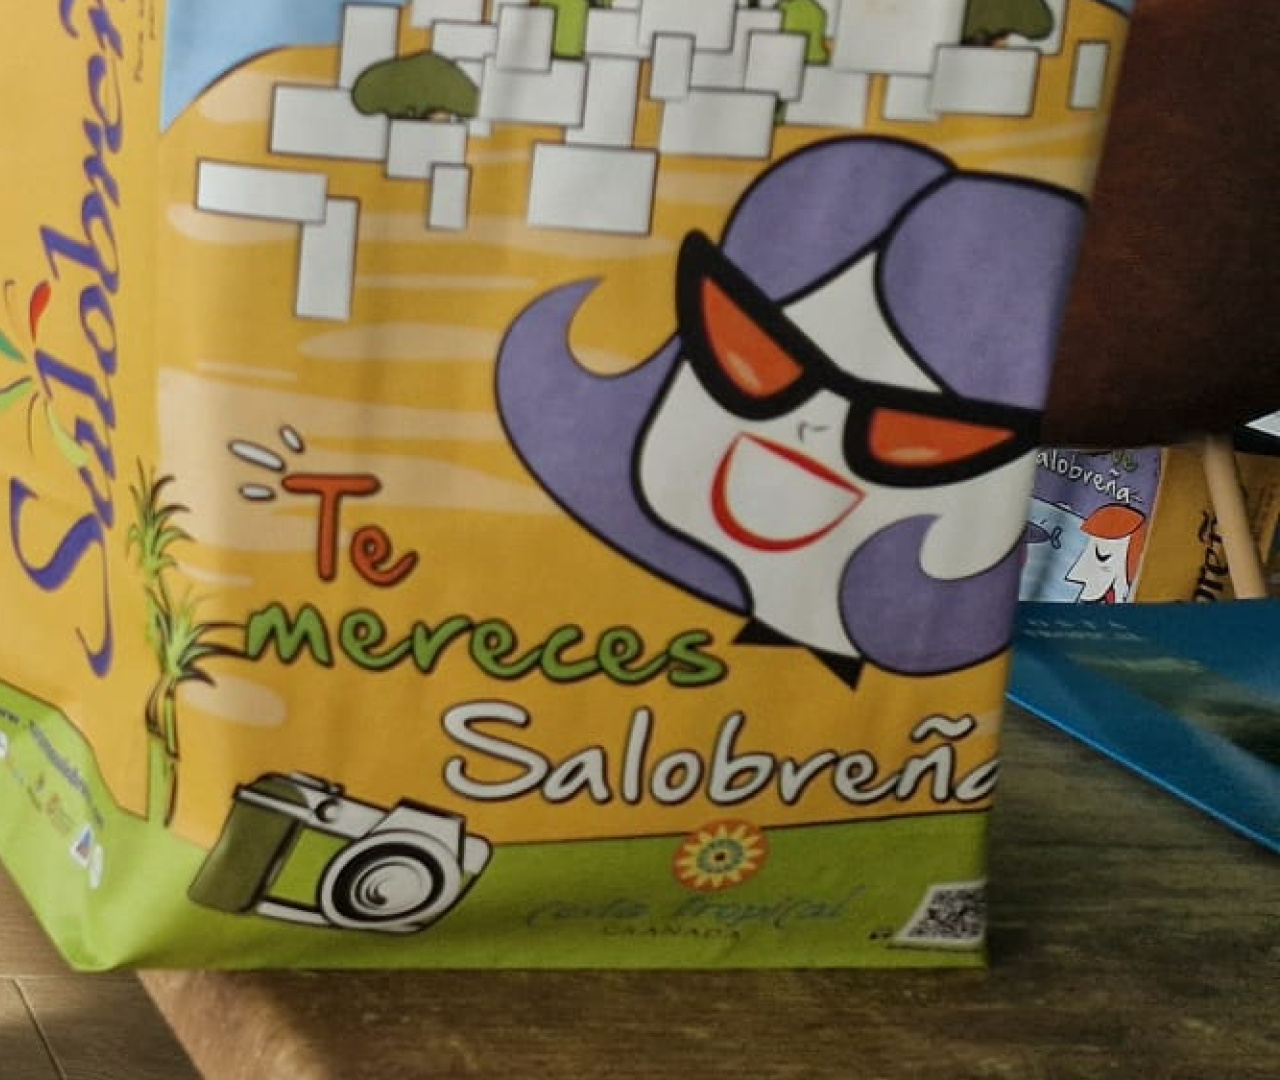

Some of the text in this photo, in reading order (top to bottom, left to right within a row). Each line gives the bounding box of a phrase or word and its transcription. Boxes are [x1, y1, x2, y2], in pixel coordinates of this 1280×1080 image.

[282, 473, 419, 586] Te
[246, 602, 728, 687] mereces
[442, 700, 1000, 807] Salobreña
